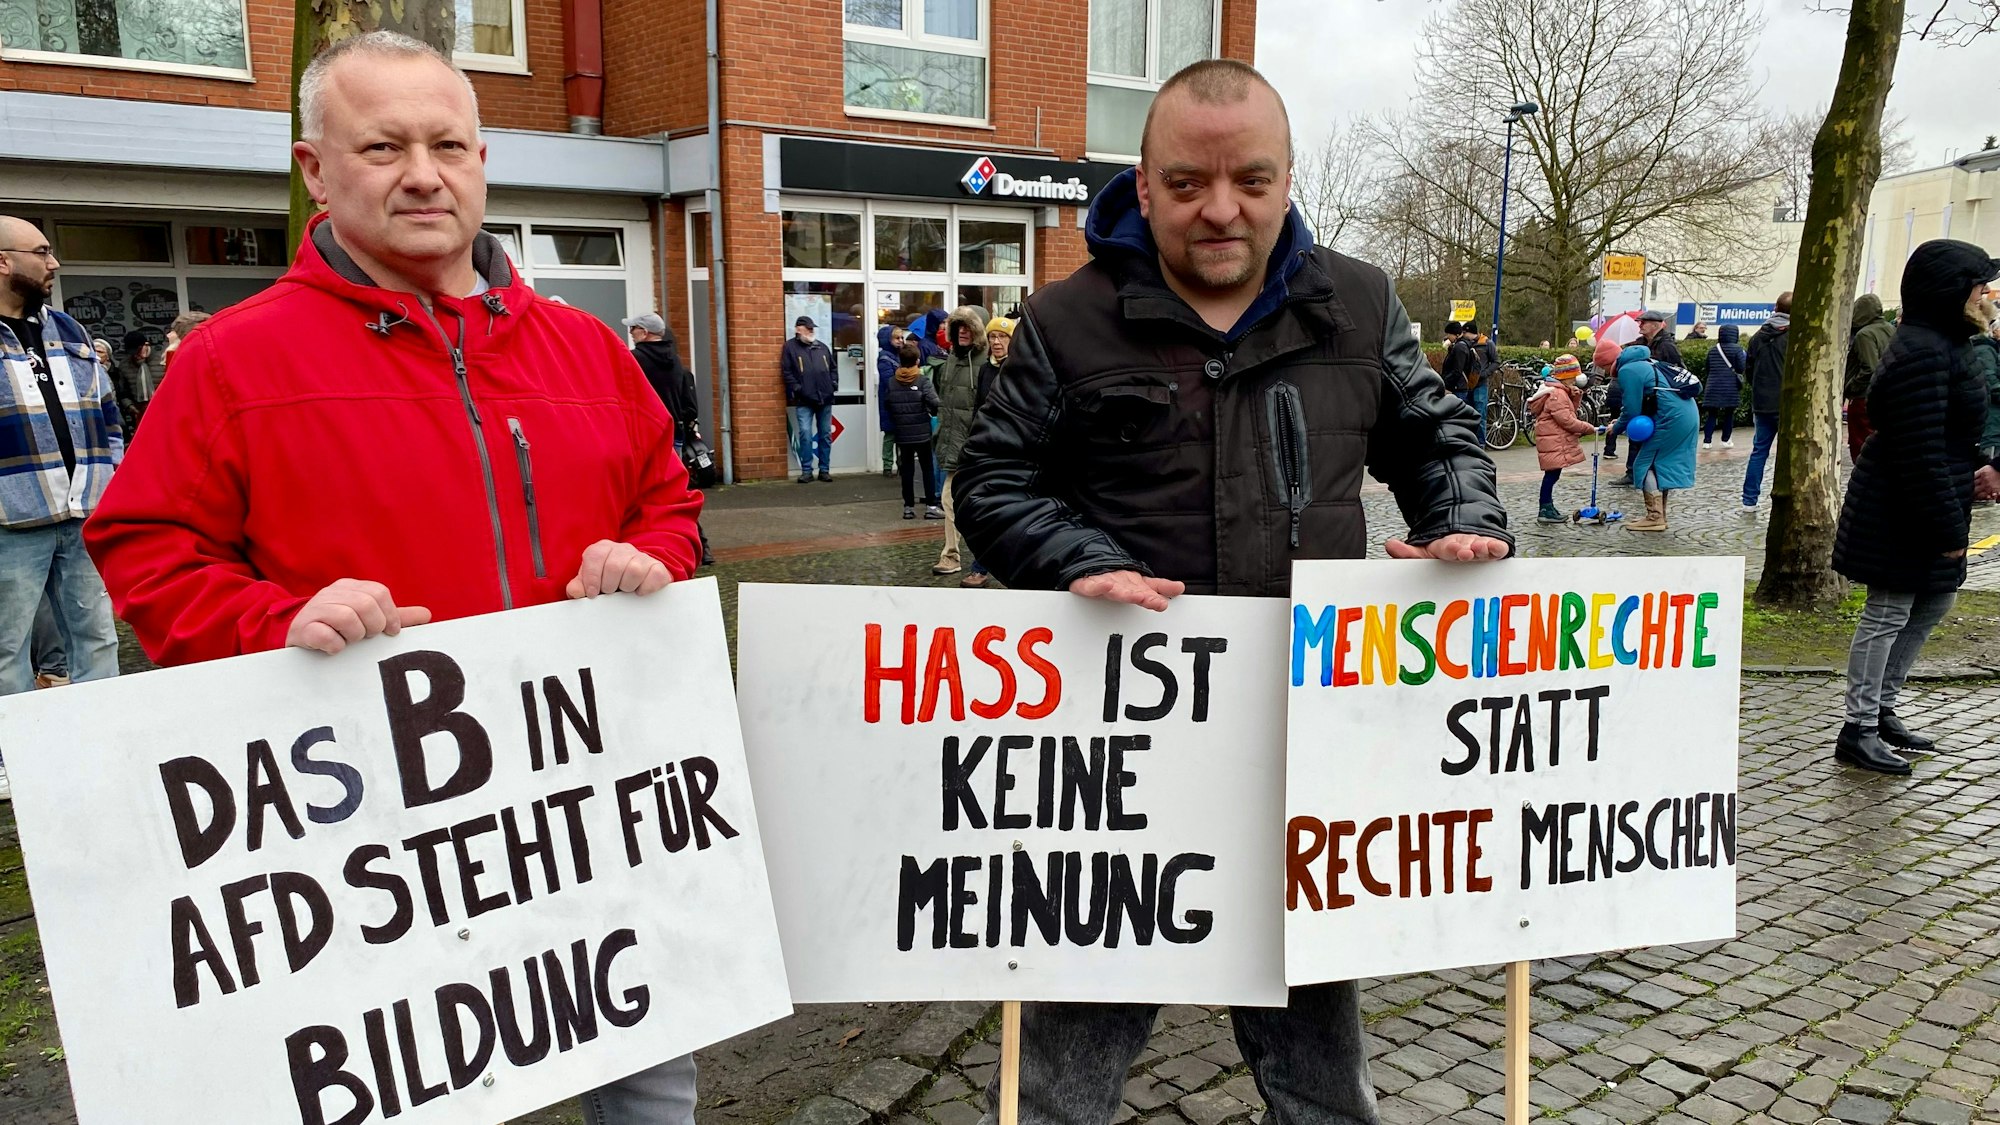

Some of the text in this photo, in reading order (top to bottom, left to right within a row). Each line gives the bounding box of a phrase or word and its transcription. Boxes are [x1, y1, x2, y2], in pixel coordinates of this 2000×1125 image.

[992, 172, 1088, 200] Domino's
[864, 623, 1228, 726] HASS IST
[1292, 591, 1719, 688] MENSCHENRECHTE
[159, 649, 604, 870] DAS B IN
[1441, 685, 1611, 776] STATT
[941, 734, 1153, 832] KEINE
[171, 755, 740, 1009] AFD STEHT FÜR
[897, 850, 1216, 953] MEINUNG
[1286, 792, 1736, 912] RECHTE MENSCHEN
[285, 928, 651, 1125] BILDUNG
